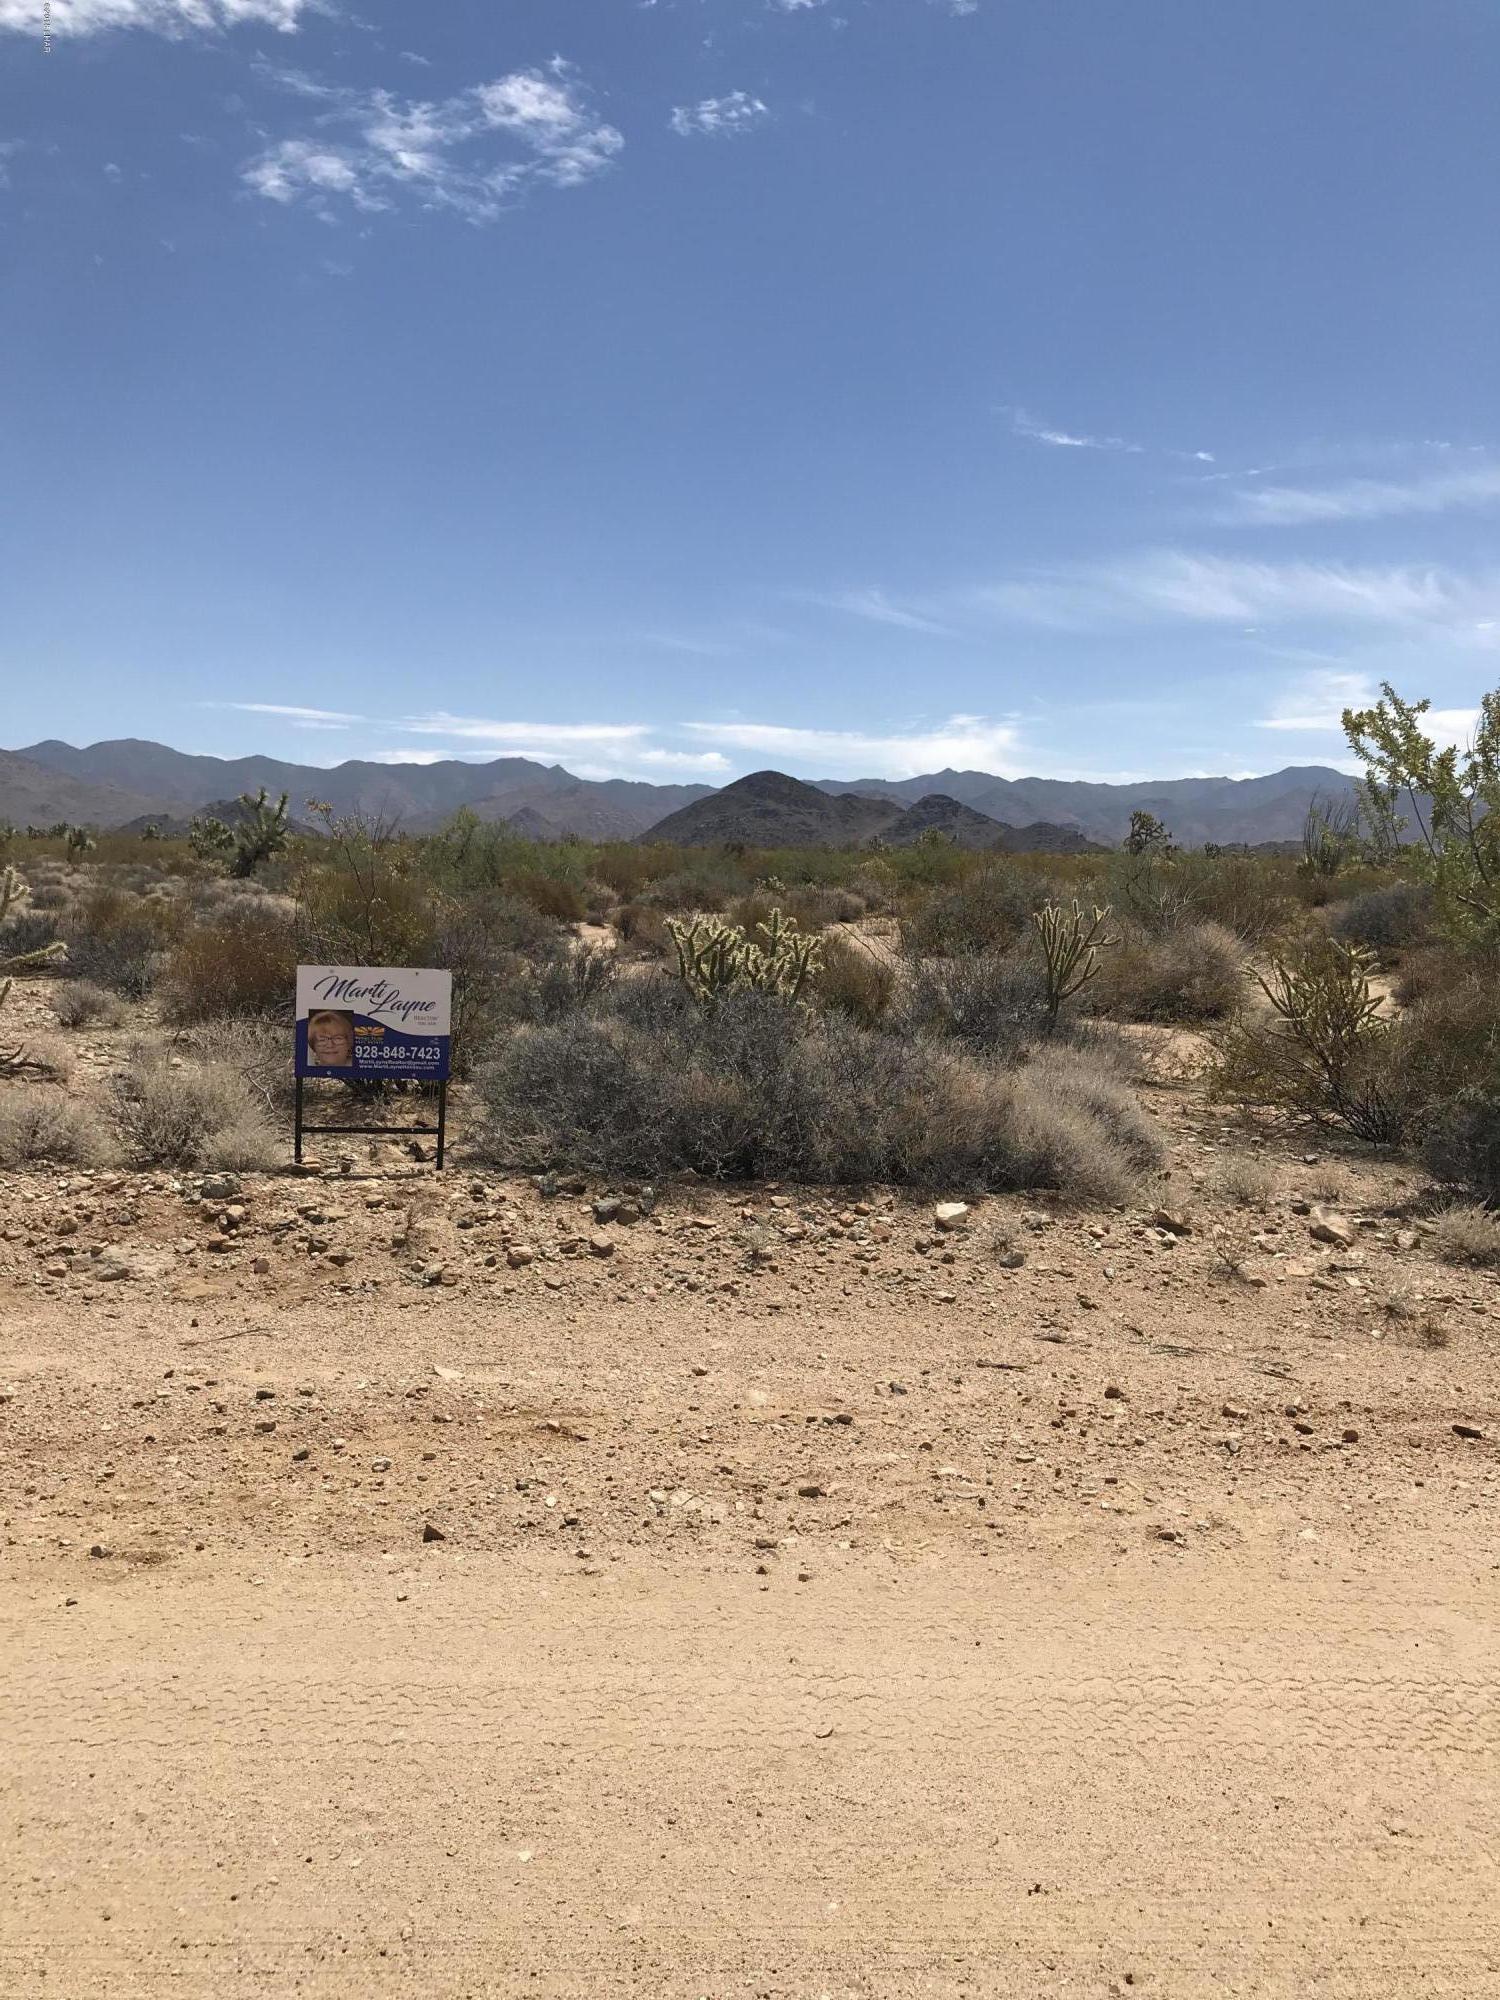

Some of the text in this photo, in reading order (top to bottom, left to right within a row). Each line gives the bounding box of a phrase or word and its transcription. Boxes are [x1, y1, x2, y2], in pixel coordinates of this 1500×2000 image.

[313, 975, 392, 1003] Marti
[367, 989, 437, 1022] Layne
[355, 1045, 441, 1060] 928-848-7423
